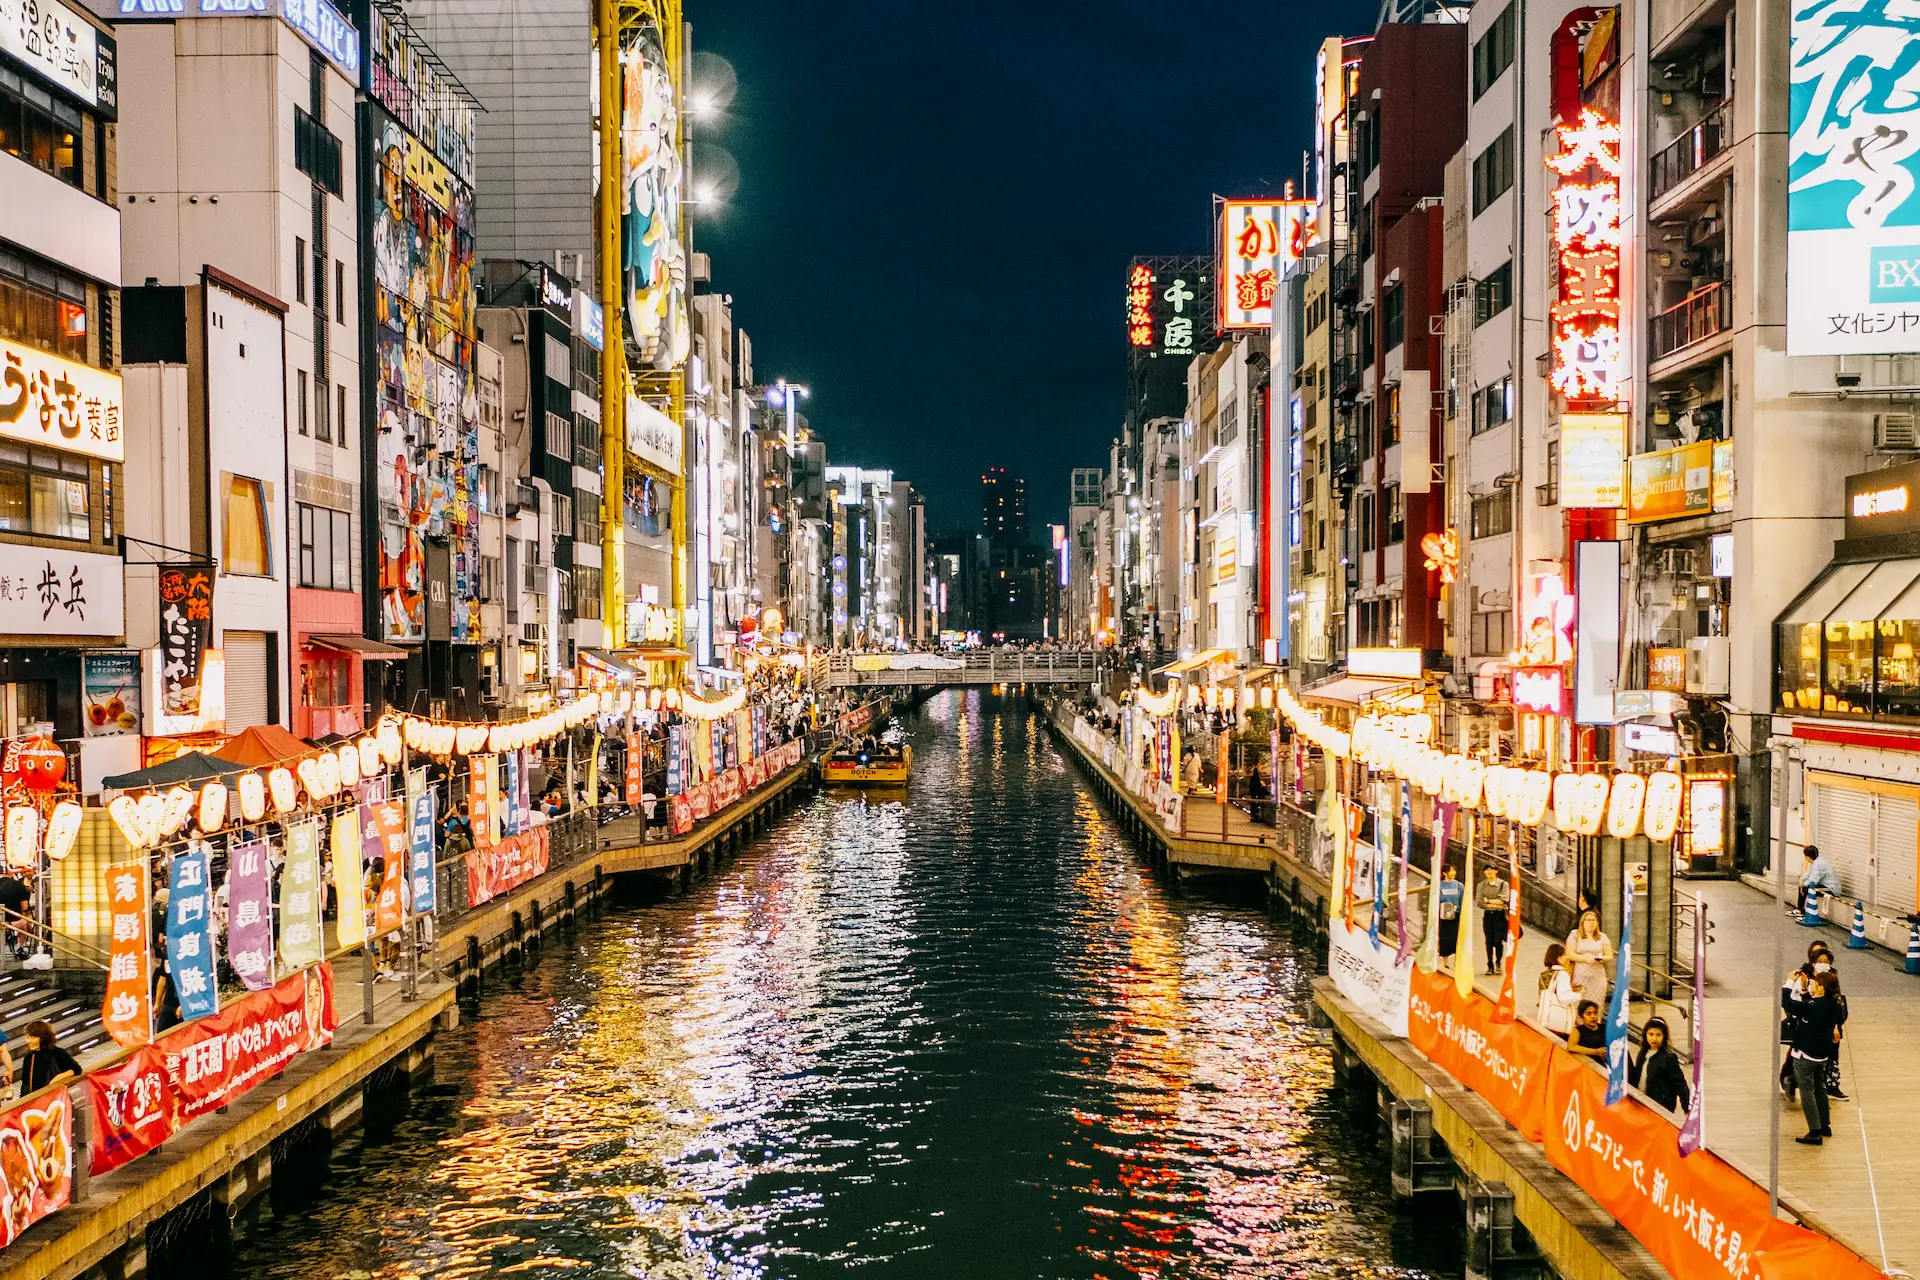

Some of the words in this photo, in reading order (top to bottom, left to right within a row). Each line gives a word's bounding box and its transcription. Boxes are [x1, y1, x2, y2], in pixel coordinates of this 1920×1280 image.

[405, 131, 450, 213] 2025
[1545, 107, 1622, 401] 大阪王将
[1131, 265, 1152, 345] お好み焼
[1163, 278, 1194, 347] 千房
[1164, 347, 1193, 355] CHIBO
[36, 560, 86, 622] 歩兵
[187, 572, 210, 620] 大阪
[163, 603, 189, 708] たこやき
